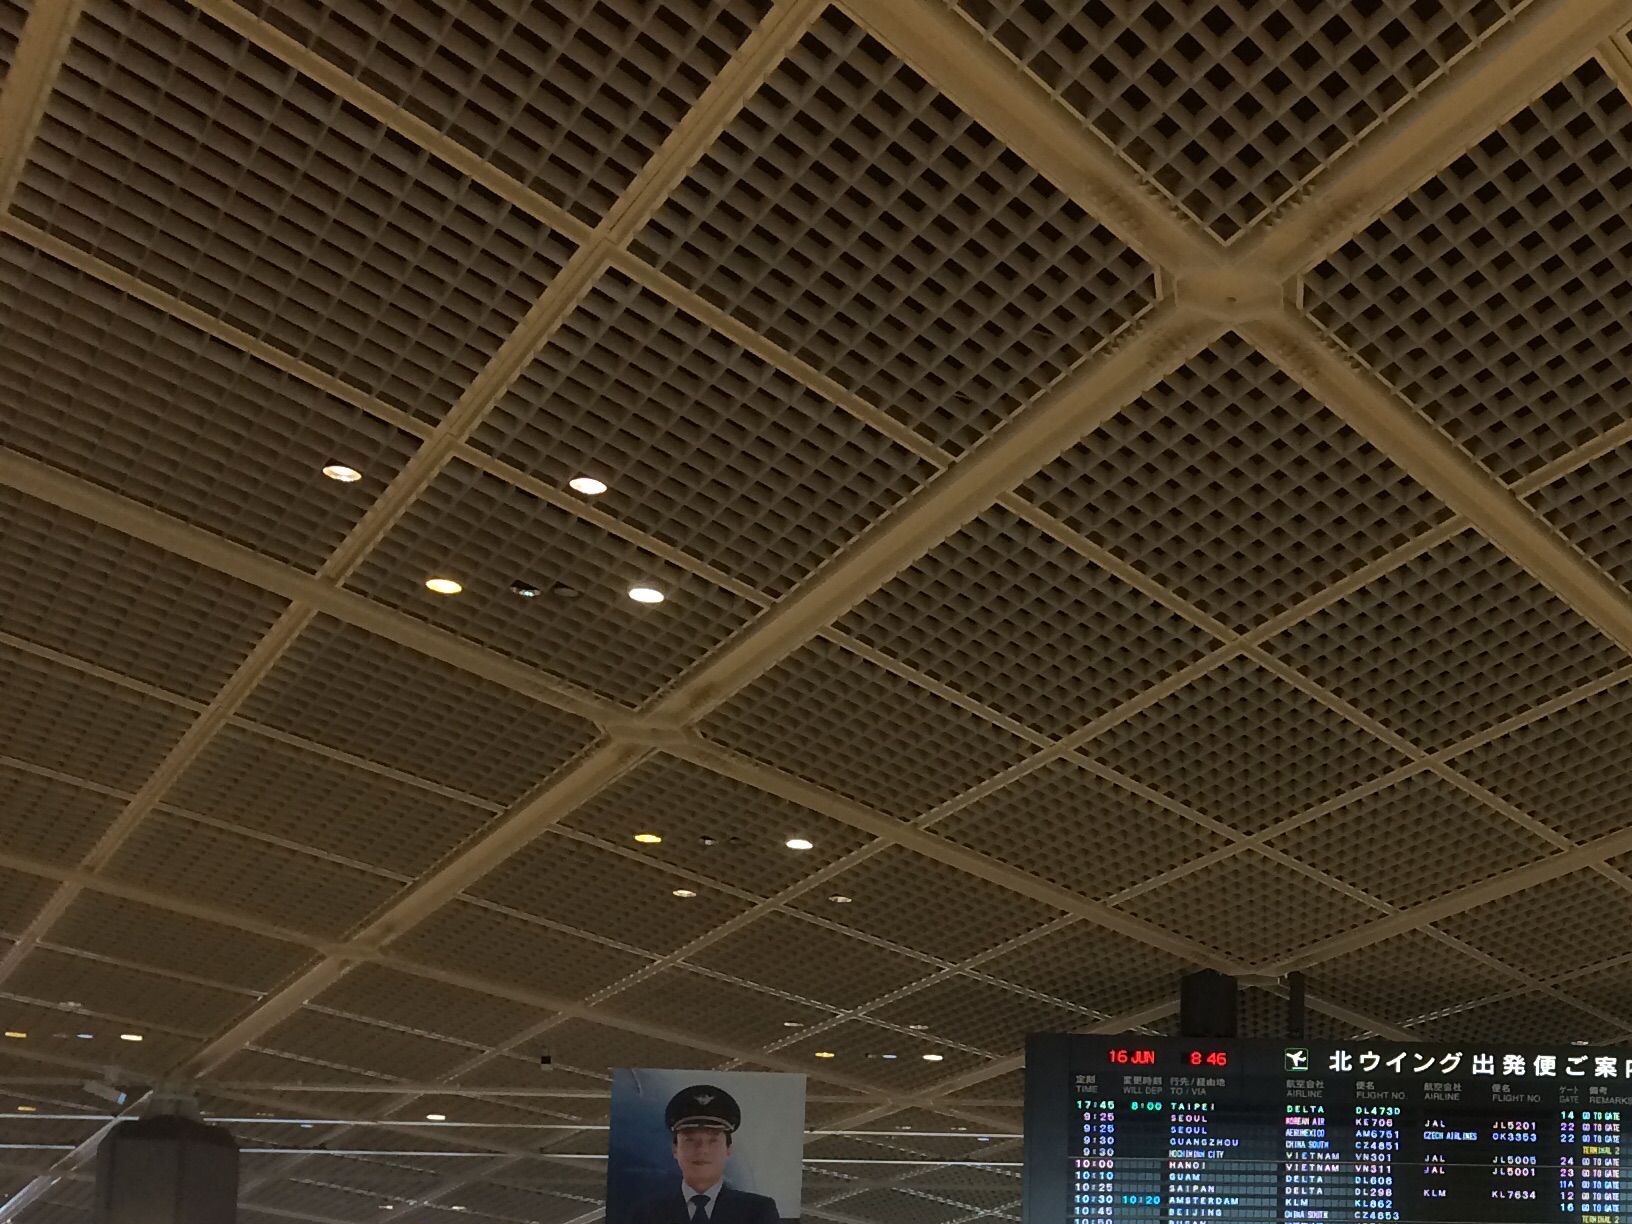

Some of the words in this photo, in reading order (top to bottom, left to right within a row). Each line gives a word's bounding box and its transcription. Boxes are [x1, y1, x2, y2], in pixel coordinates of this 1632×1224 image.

[1108, 1050, 1128, 1064] 16
[1131, 1050, 1155, 1064] JUN
[1076, 1085, 1098, 1093] TIME
[1286, 1089, 1322, 1098] AIRLINE
[1076, 1100, 1115, 1110] 17:45
[1170, 1102, 1215, 1111] TAIPEI
[1286, 1105, 1325, 1113] DELTA
[1170, 1114, 1207, 1122] SEOUL
[1560, 1111, 1575, 1120] 14
[1170, 1126, 1207, 1134] SEOUL
[1425, 1120, 1445, 1128] JAL
[1560, 1123, 1575, 1132] 22
[1169, 1138, 1239, 1147] GUANGZHOU
[1560, 1134, 1575, 1143] 22
[1286, 1152, 1339, 1160] VIETNAM
[1355, 1153, 1392, 1162] VN301
[1075, 1159, 1114, 1168] 10:00
[1169, 1161, 1206, 1169] HANOI
[1286, 1164, 1339, 1172] VIETNAM
[1355, 1165, 1392, 1174] VN311
[1560, 1169, 1574, 1177] 23
[1169, 1173, 1200, 1181] GUAM
[1286, 1175, 1323, 1183] DELTA
[1169, 1185, 1215, 1193] SAIPAN
[1423, 1189, 1447, 1198] KLM
[1560, 1192, 1574, 1200] 12
[1169, 1197, 1239, 1205] AMSTERDAM
[1285, 1199, 1308, 1207] KLM
